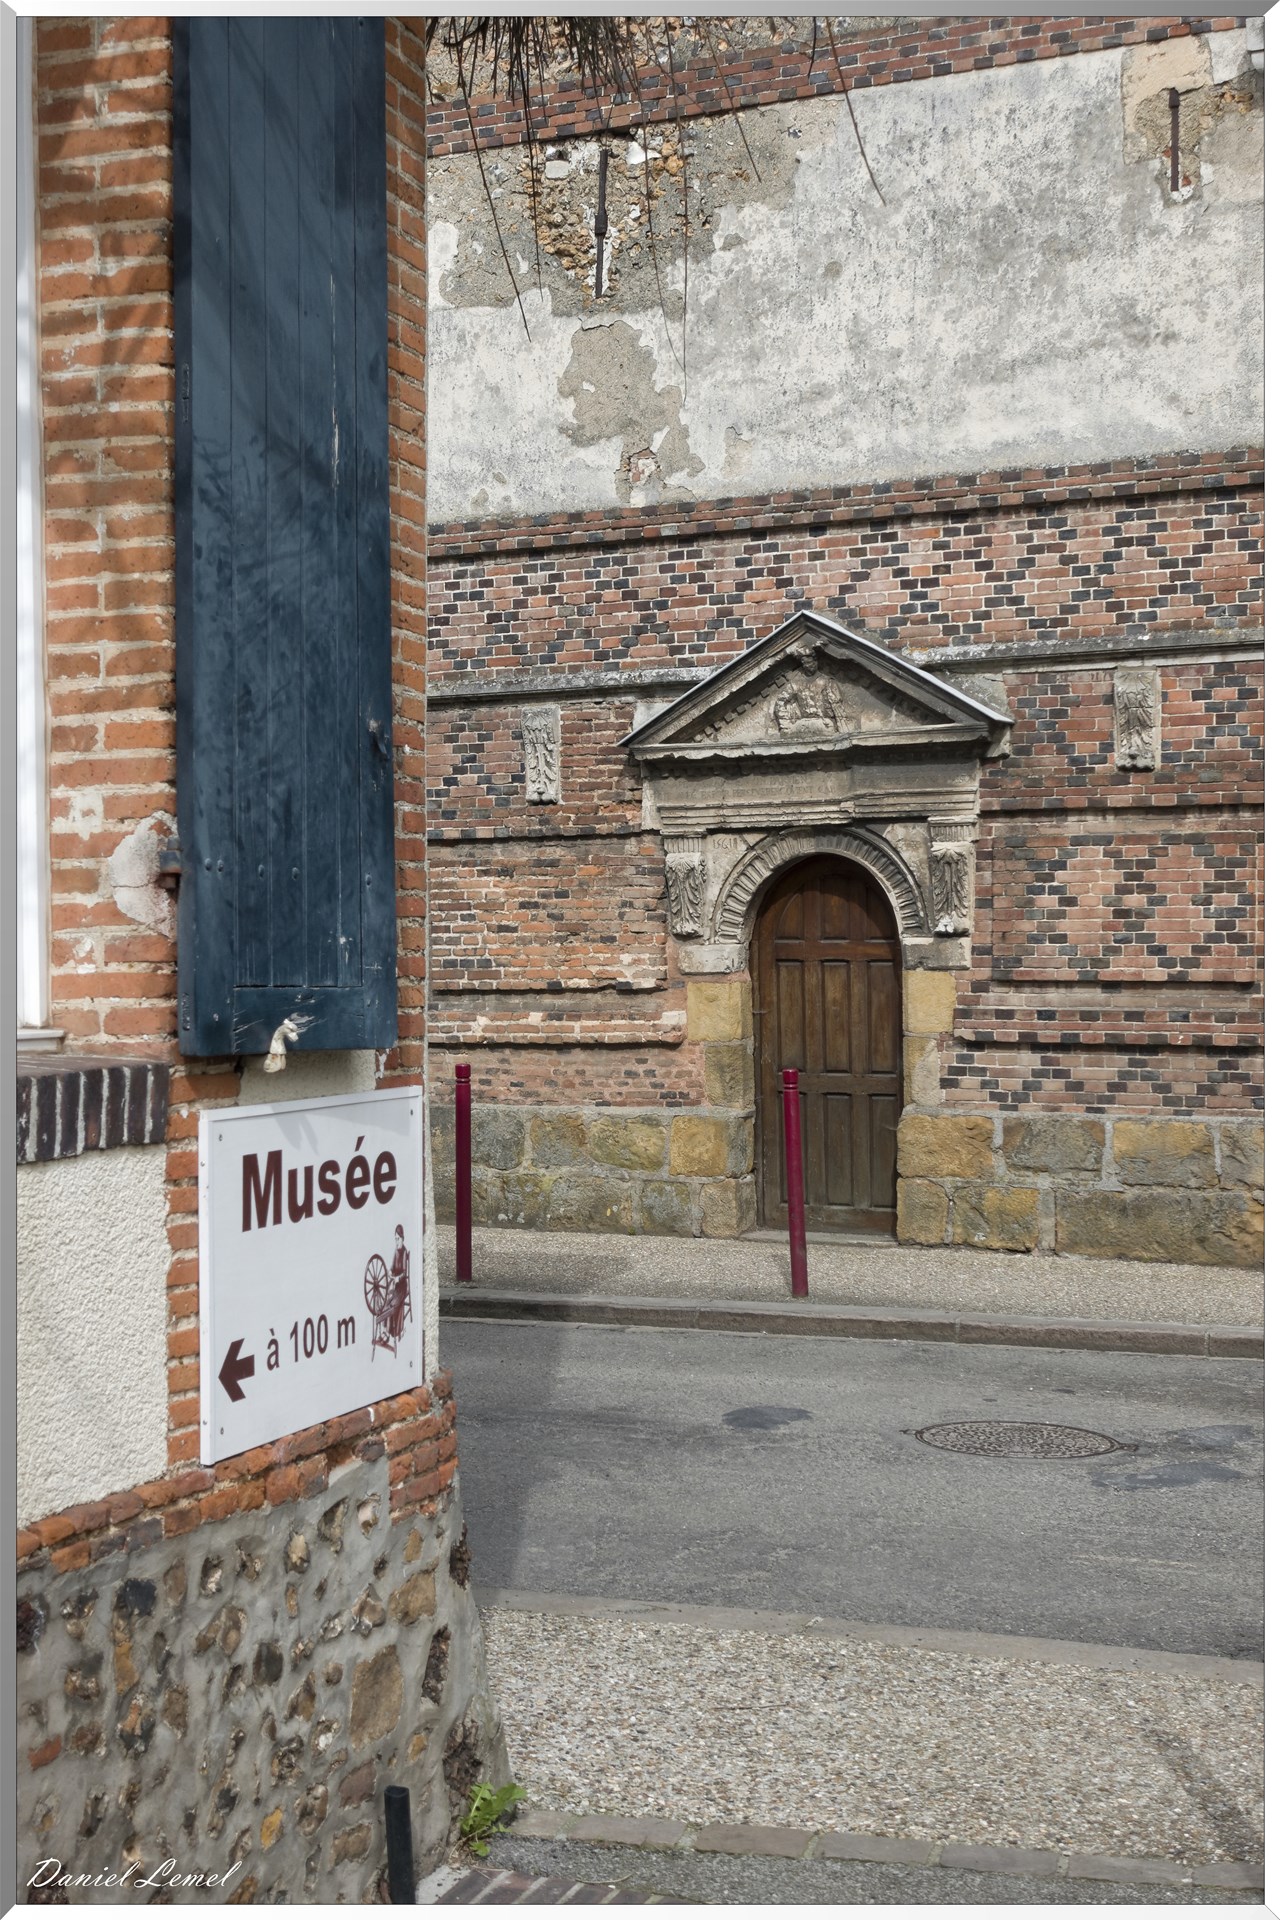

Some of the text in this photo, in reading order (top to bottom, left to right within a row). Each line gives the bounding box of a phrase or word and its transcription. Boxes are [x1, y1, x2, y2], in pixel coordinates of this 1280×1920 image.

[241, 1135, 398, 1233] Musée
[266, 1314, 356, 1371] à 100 m
